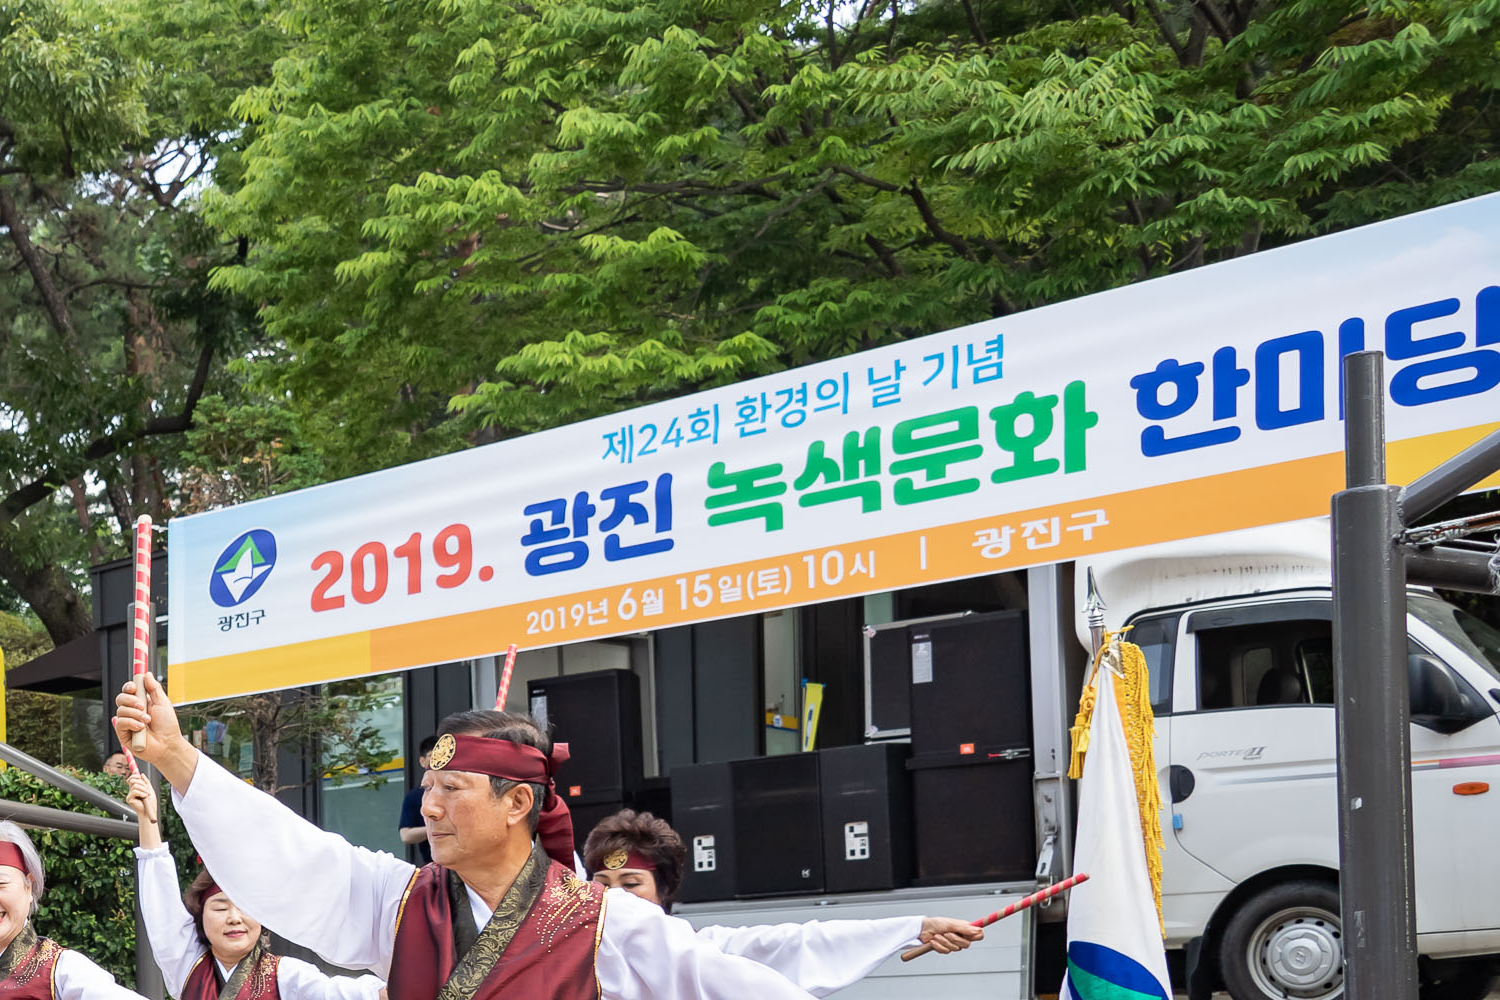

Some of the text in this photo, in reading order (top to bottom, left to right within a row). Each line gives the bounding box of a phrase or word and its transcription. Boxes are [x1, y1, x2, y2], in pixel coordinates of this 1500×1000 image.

[602, 333, 1005, 465] 제24회 환경의 날 기념
[311, 523, 494, 612] 2019.
[520, 472, 675, 577] 광진
[704, 380, 1099, 533] 녹색문화
[971, 508, 1110, 559] 광진구
[217, 608, 267, 632] 광진구
[526, 549, 876, 635] 2019년 6월 15일(토) 10시
